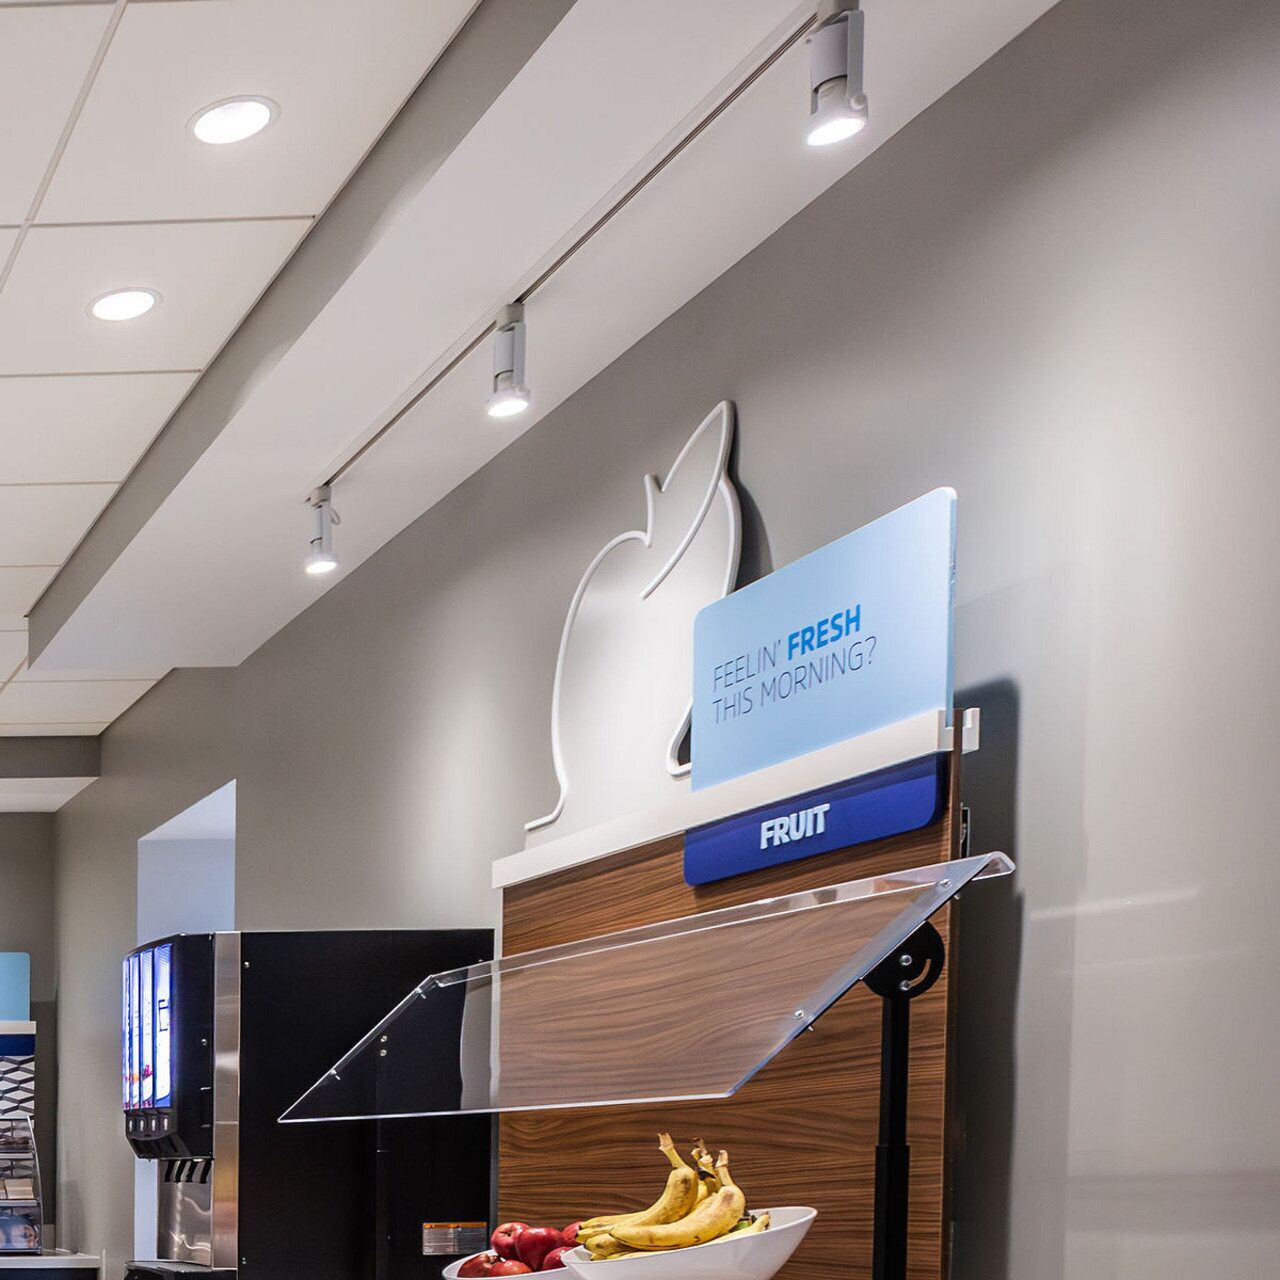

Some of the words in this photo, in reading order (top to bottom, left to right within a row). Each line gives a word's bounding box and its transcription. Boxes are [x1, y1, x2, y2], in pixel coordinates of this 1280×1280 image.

[712, 686, 753, 724] THIS
[760, 635, 878, 707] MORNING?
[713, 639, 781, 693] FEELIN'
[787, 603, 862, 662] FRESH
[759, 802, 831, 850] FRUIT
